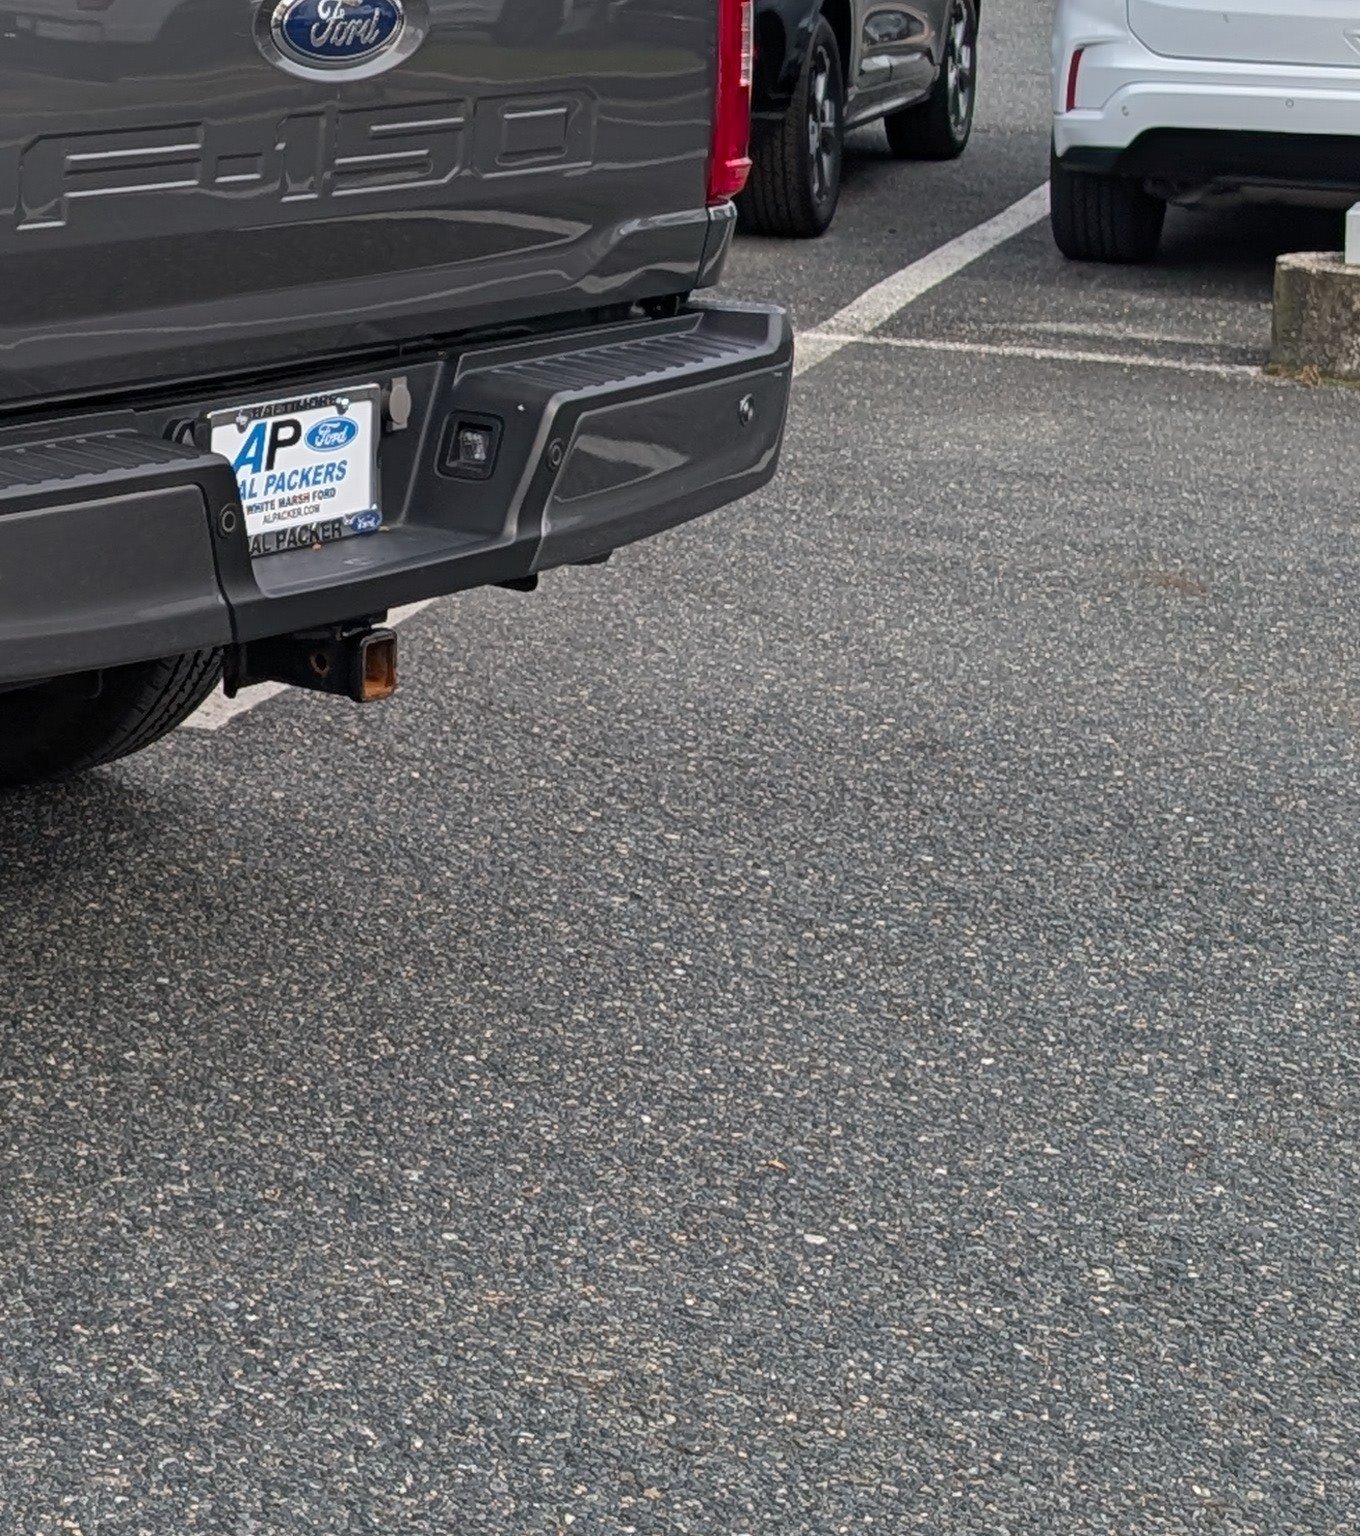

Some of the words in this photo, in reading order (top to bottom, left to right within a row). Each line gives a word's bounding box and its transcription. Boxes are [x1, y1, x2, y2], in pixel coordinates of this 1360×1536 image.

[15, 88, 598, 231] F-150
[233, 417, 303, 475] AP
[312, 419, 352, 449] Ford
[238, 477, 258, 501] AL
[263, 459, 348, 497] PACKERS
[246, 498, 276, 516] WHITE
[278, 491, 311, 509] MARSH
[312, 487, 337, 503] FORD
[262, 504, 321, 525] ALPACKER.COM
[249, 533, 272, 556] AL
[275, 516, 342, 549] PACKER
